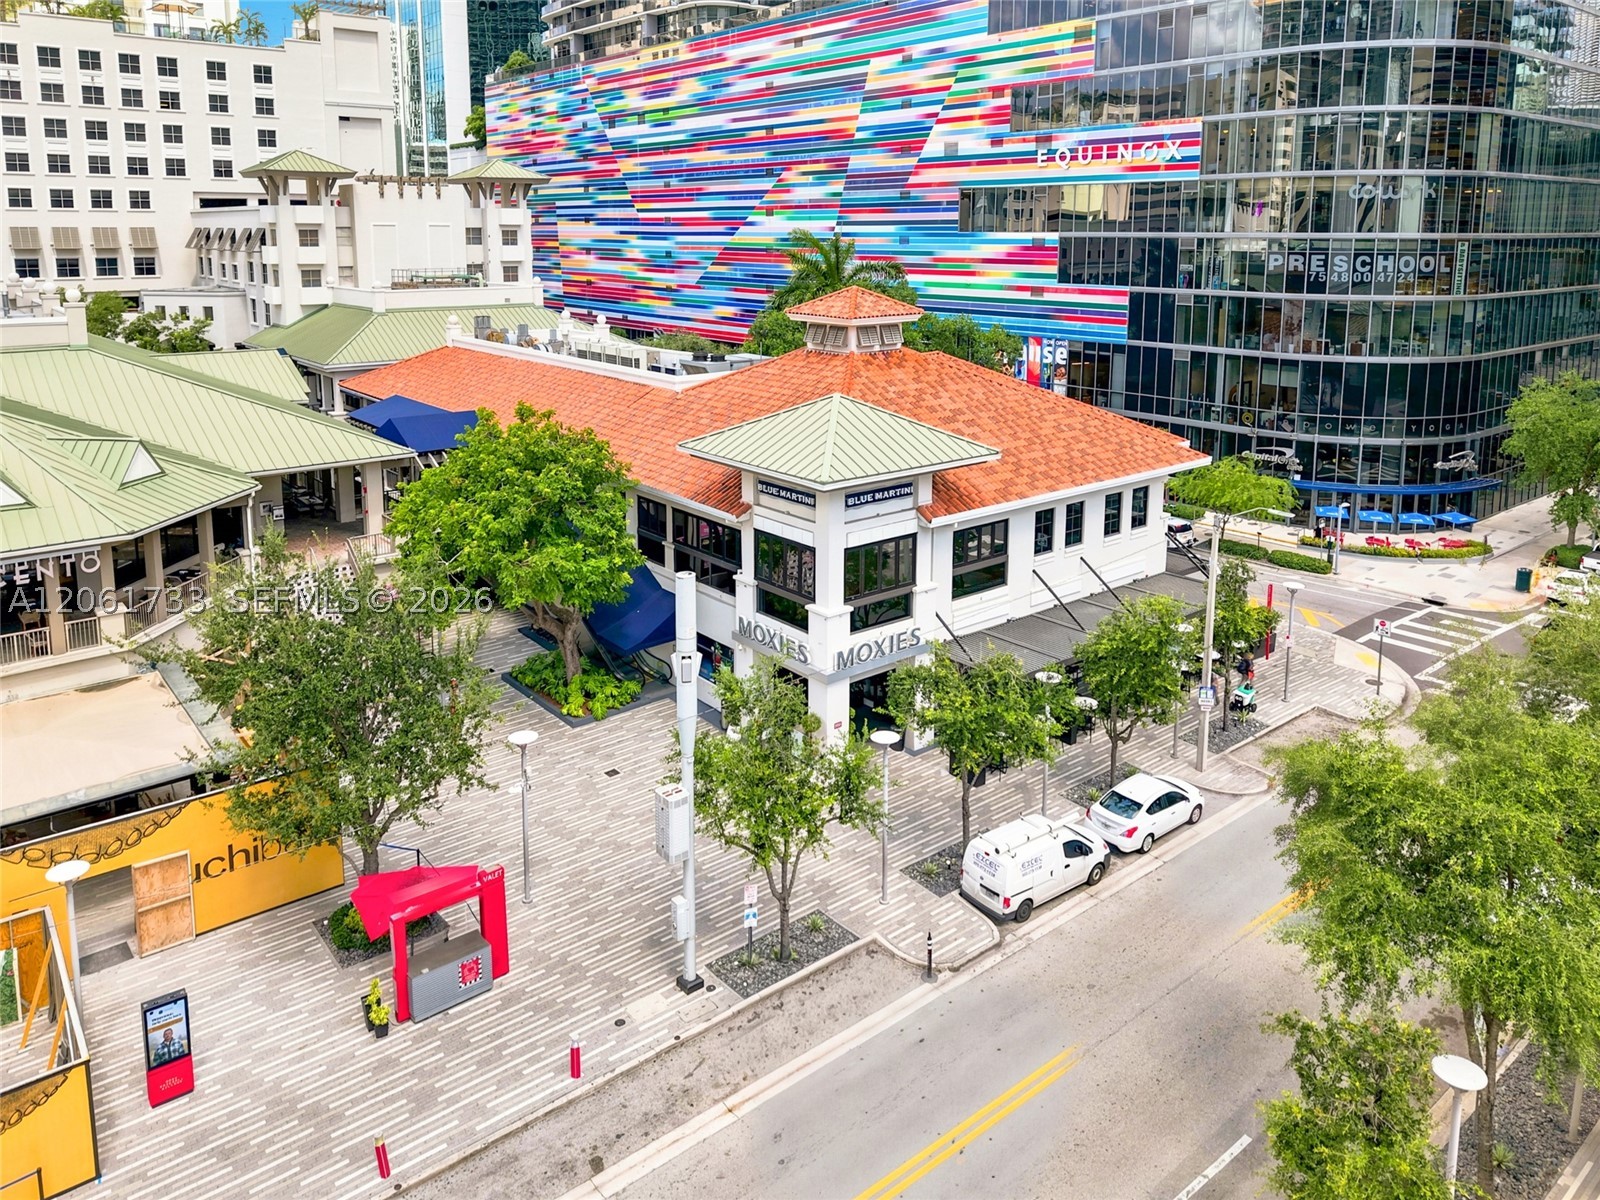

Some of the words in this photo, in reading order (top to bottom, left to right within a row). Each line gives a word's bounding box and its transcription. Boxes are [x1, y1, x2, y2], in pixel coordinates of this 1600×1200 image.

[1037, 140, 1182, 170] EQUINOX
[1268, 254, 1450, 273] PRESCHOOL
[758, 483, 779, 496] BLUE
[779, 490, 815, 506] MARTINI
[847, 493, 873, 505] BLUE
[874, 486, 913, 500] MARTINI
[738, 616, 811, 665] MOXIES
[834, 627, 922, 671] MOXIES
[483, 869, 503, 882] VALET
